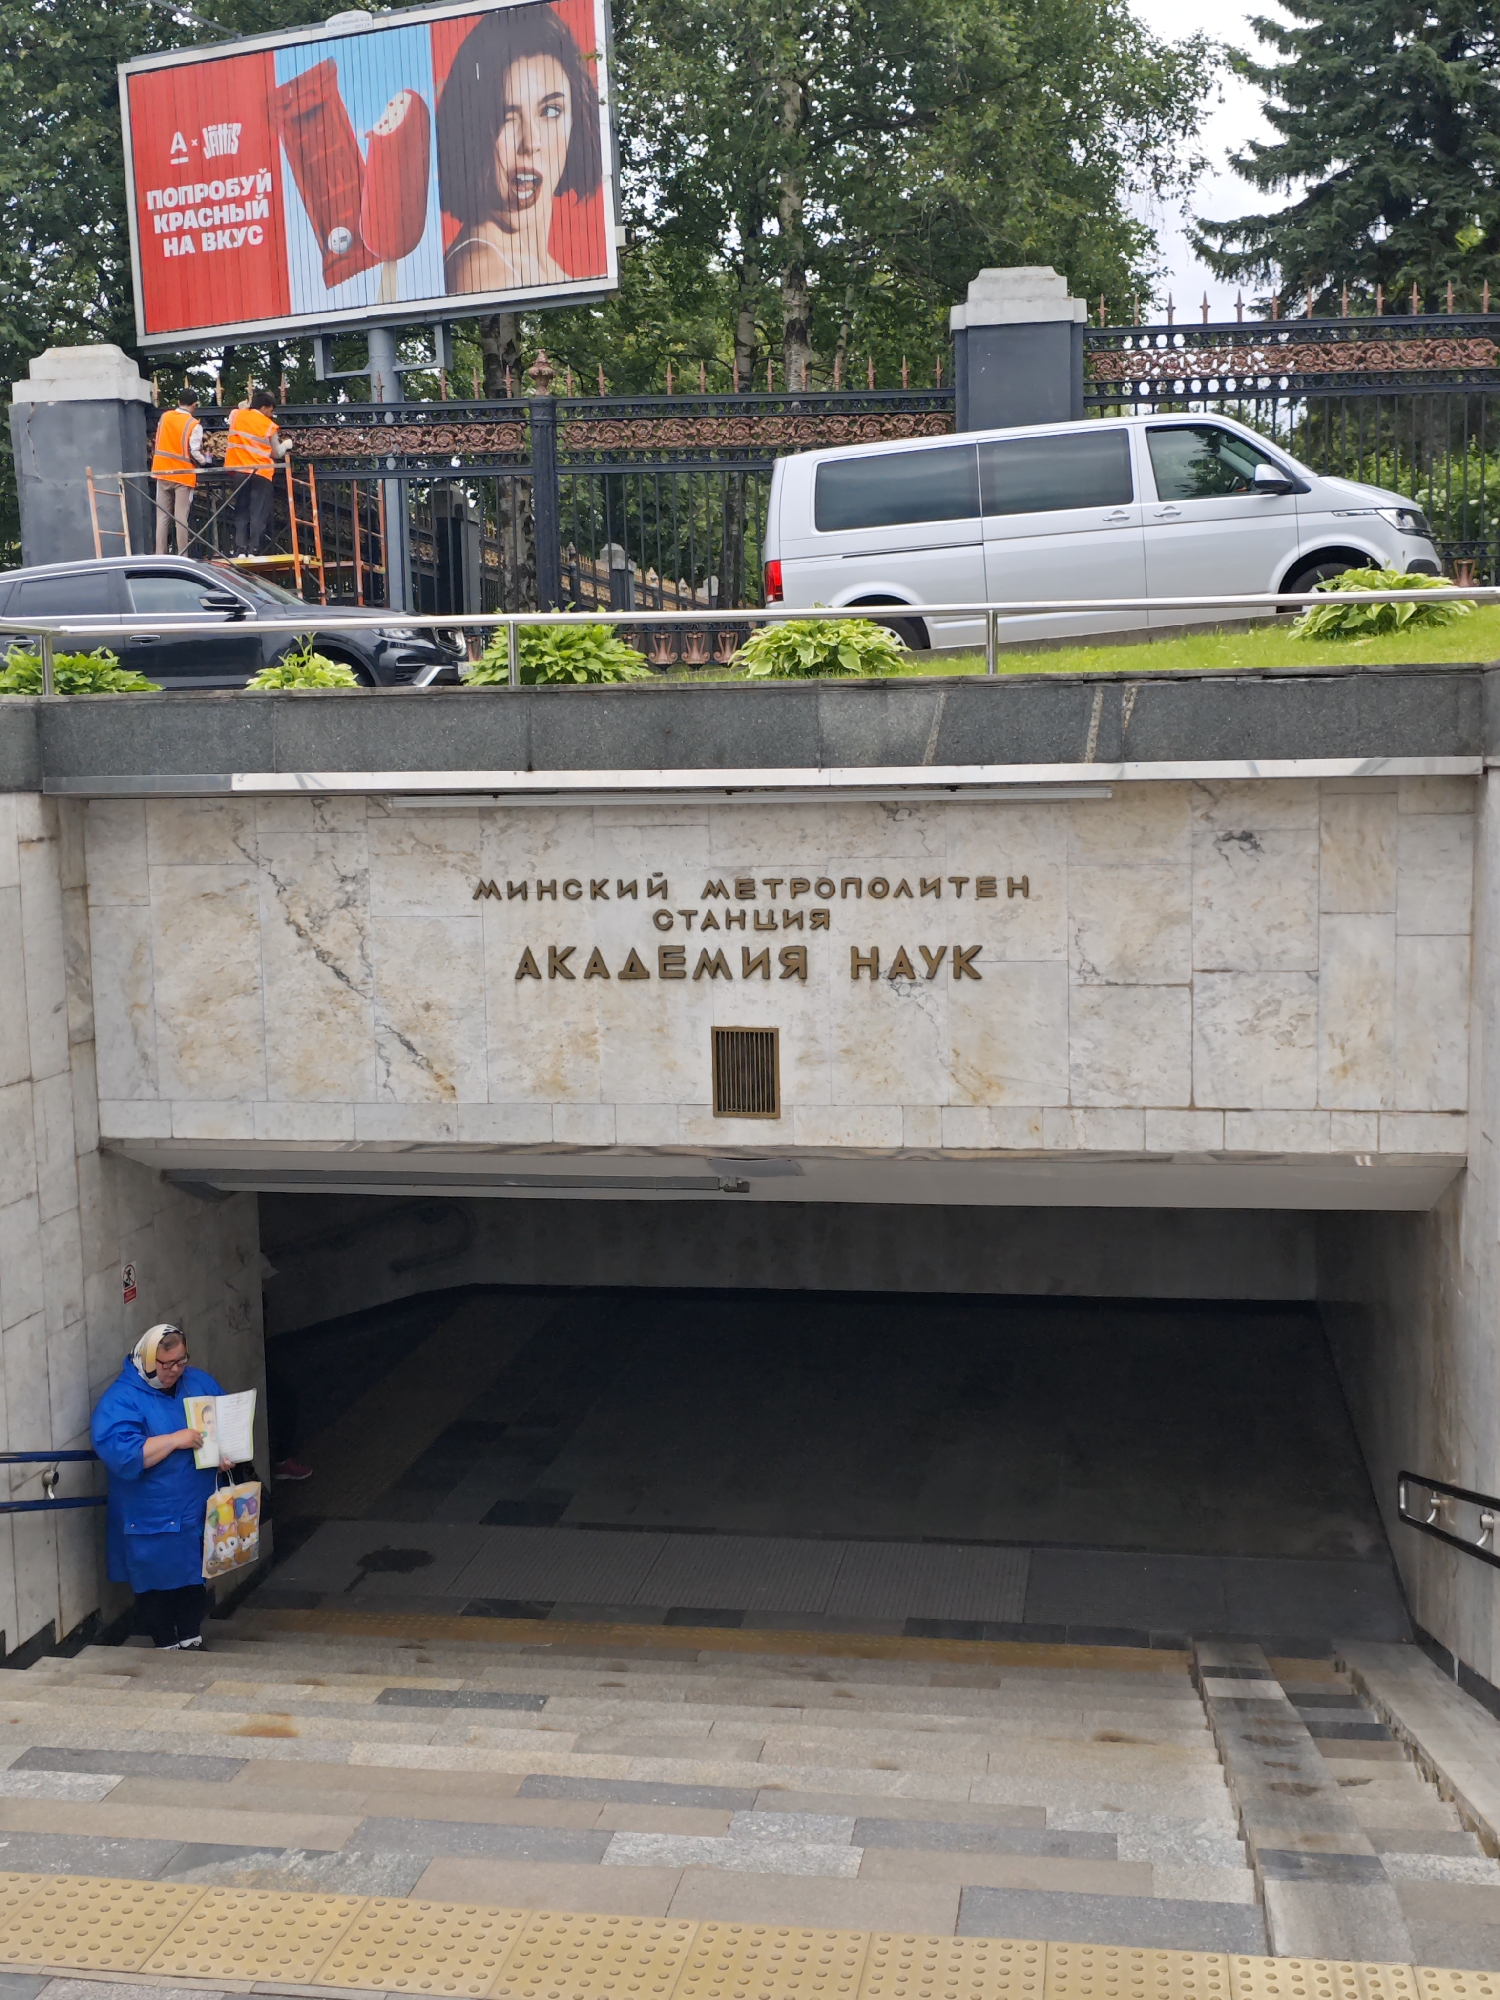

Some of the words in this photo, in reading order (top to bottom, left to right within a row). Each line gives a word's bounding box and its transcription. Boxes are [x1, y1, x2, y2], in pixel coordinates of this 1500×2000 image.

[146, 167, 272, 211] ПОПРОБУЙ
[153, 193, 270, 234] КРАСНЫЙ
[163, 235, 196, 258] НА
[201, 225, 264, 252] ВКУС
[472, 872, 668, 901] МИНСКИЙ
[700, 875, 1029, 900] МЕТРОПОЛИТЕН
[653, 908, 830, 931] СТАНЦИЯ
[515, 945, 808, 980] АКАДЕМИЯ
[850, 945, 982, 980] НАУК
